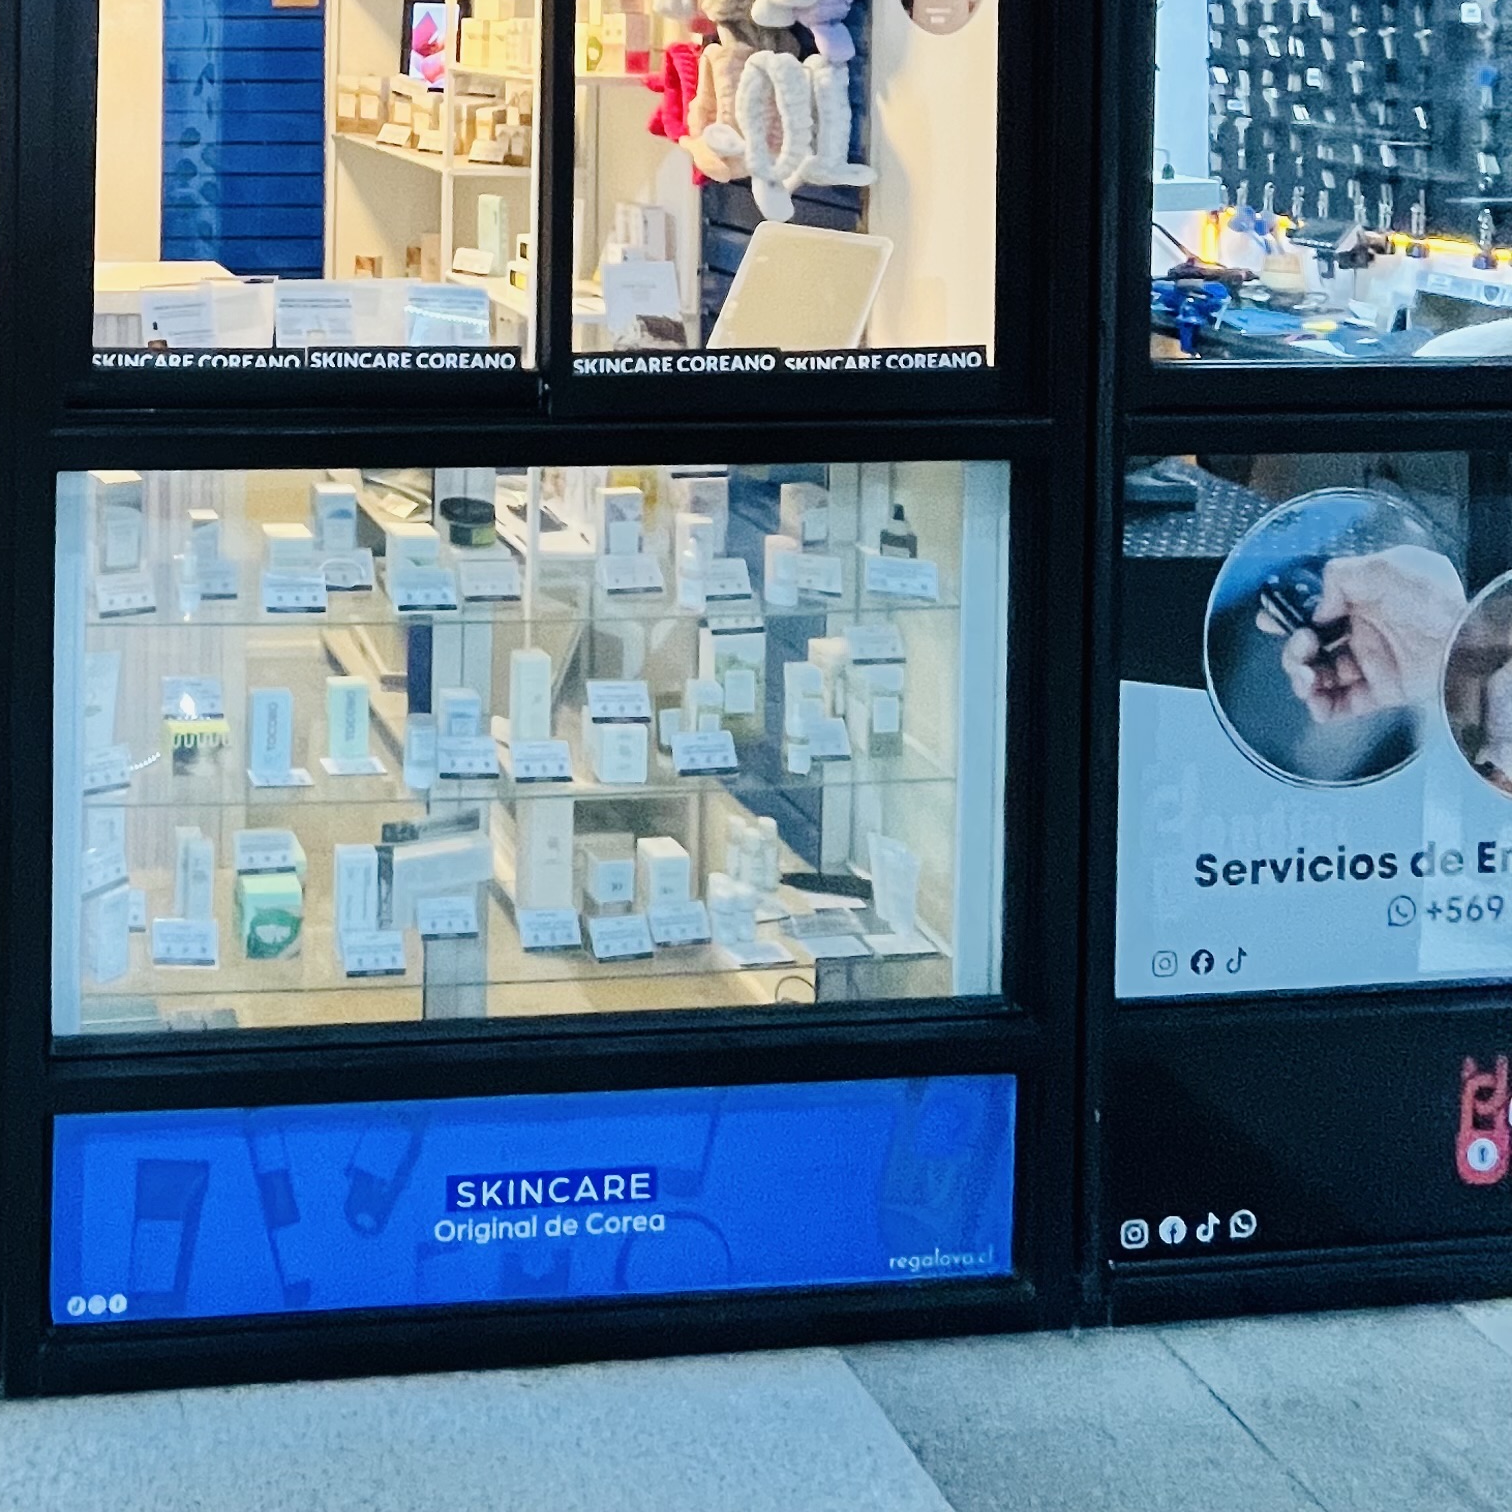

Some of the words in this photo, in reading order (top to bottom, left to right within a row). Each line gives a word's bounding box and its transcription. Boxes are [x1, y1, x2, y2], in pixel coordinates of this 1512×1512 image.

[309, 351, 412, 369] SKINCARE
[416, 351, 517, 369] COREANO
[572, 356, 673, 374] SKINCARE
[677, 354, 777, 373] COREANO
[1195, 845, 1399, 888] Servicios
[1409, 840, 1465, 878] de
[1425, 894, 1507, 925] +569
[455, 1172, 652, 1209] SKINCARE
[433, 1214, 538, 1244] Original
[544, 1214, 579, 1237] de
[585, 1212, 666, 1235] Corea
